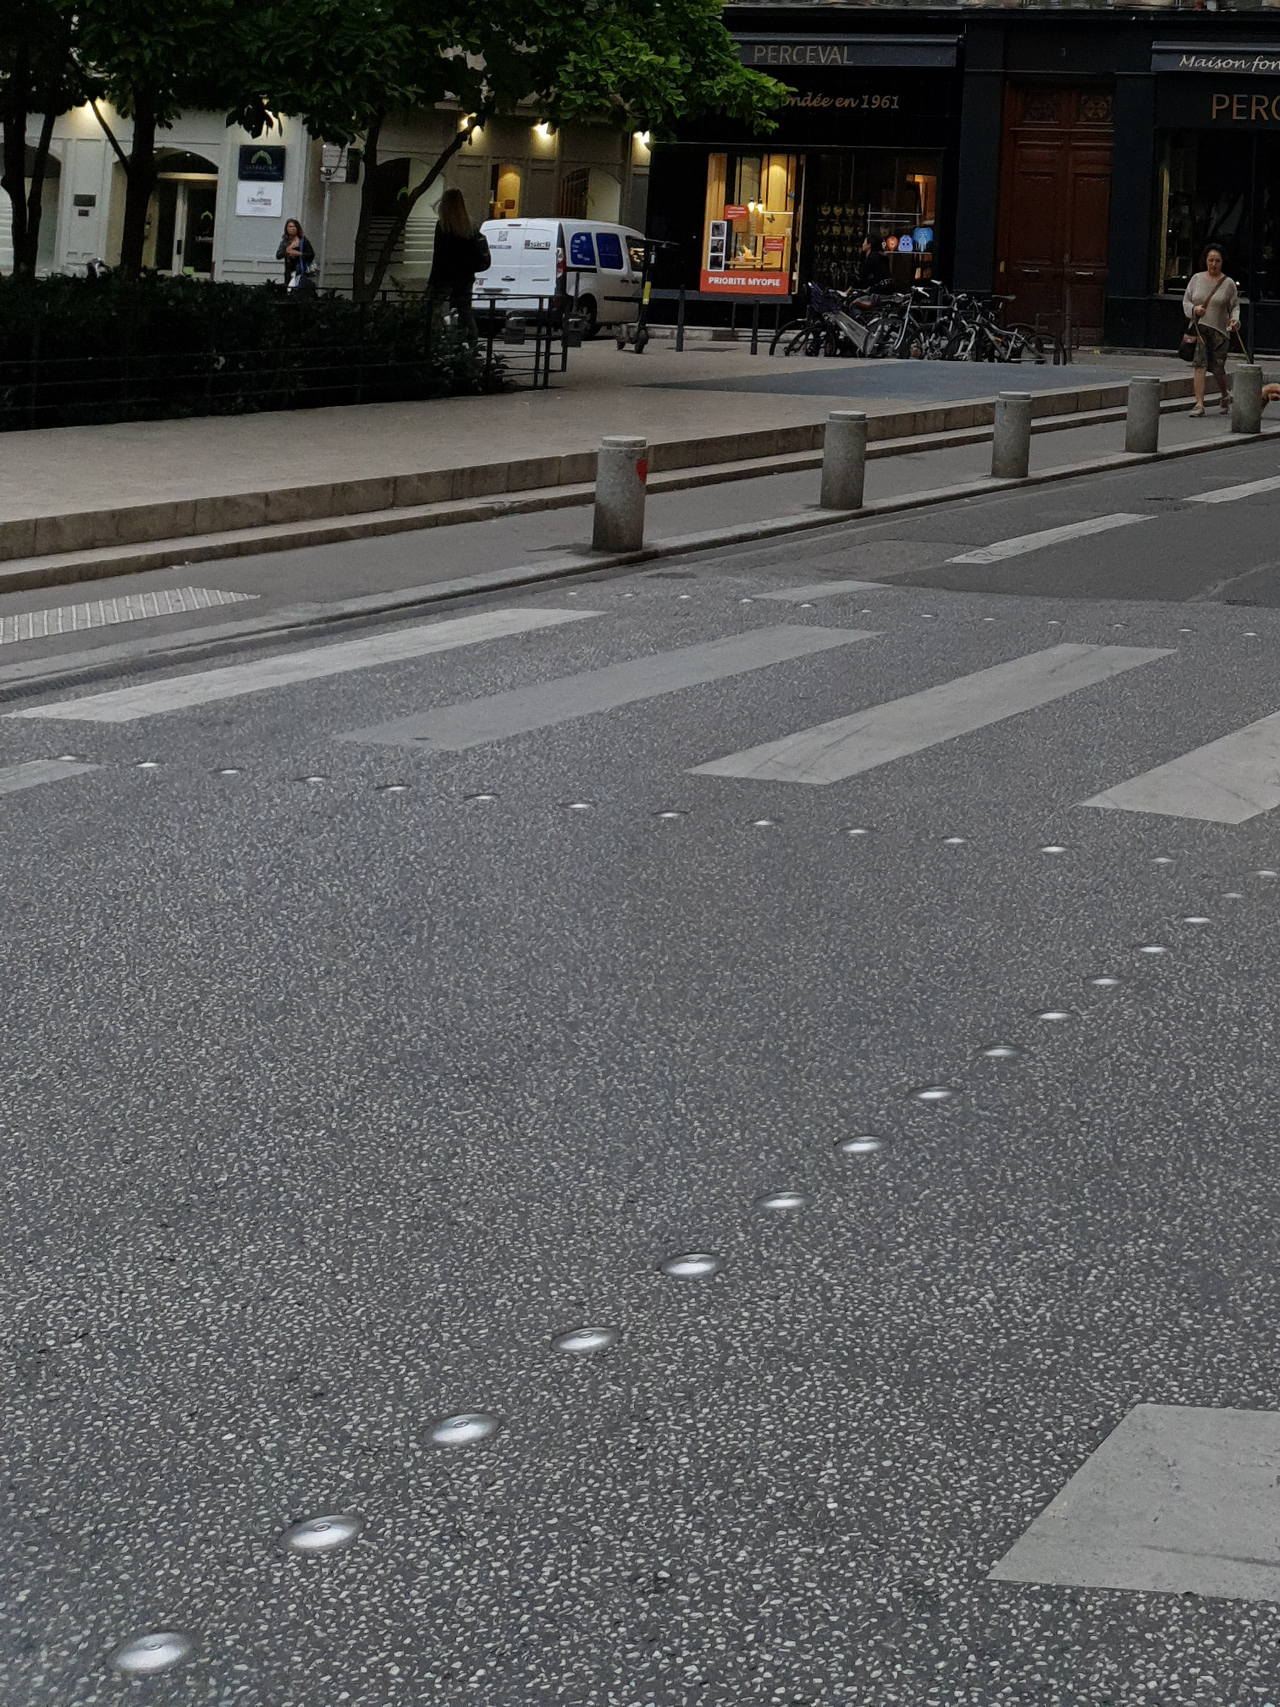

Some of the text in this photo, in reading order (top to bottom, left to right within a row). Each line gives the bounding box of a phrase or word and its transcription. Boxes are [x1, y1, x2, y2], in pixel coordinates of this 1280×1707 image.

[753, 45, 853, 64] PERCEVAL
[1179, 54, 1250, 71] Maison
[781, 92, 899, 109] ondée en 1961
[708, 277, 780, 287] PRIORITE MYOPIE
